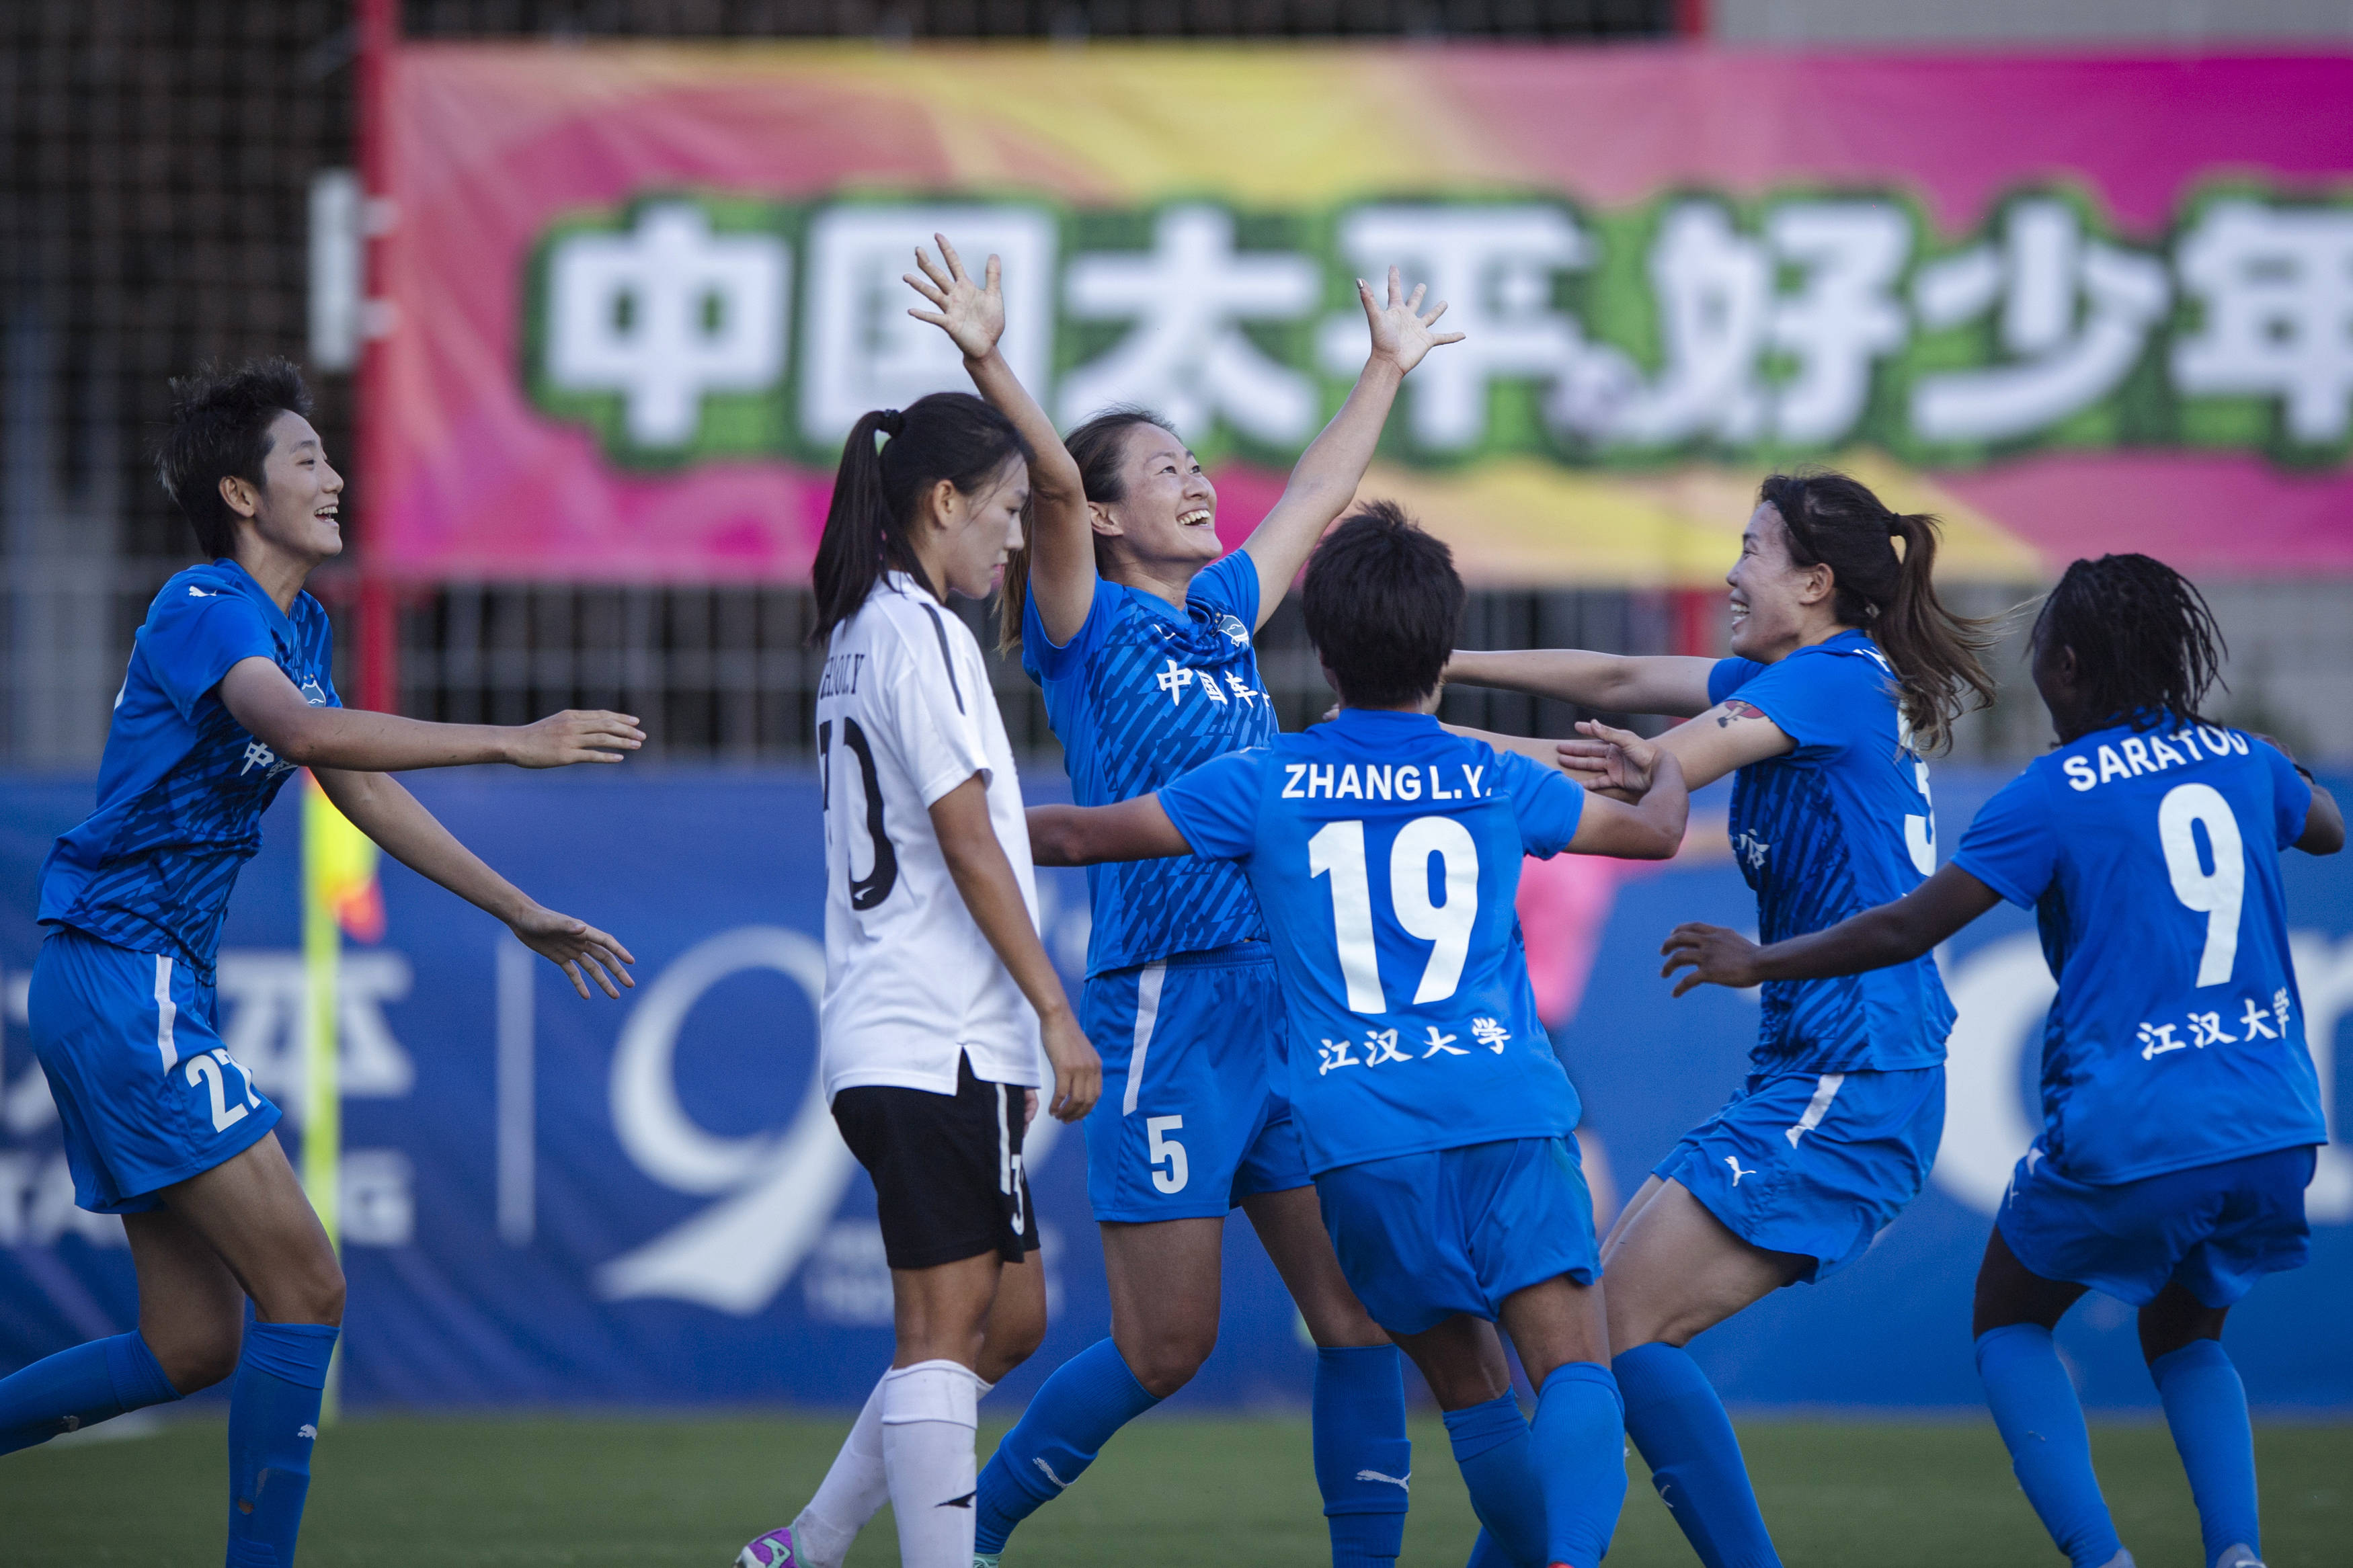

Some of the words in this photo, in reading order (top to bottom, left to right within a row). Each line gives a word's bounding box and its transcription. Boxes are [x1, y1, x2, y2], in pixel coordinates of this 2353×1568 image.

[546, 199, 2353, 446] 中国太平好少年
[1156, 659, 1271, 708] 中国车
[1281, 764, 1422, 801] ZHANG
[1429, 764, 1492, 801] L.Y.
[1308, 815, 1479, 1015] 19
[2158, 782, 2245, 989] 9
[1318, 1016, 1512, 1076] 江汉大学
[2135, 987, 2290, 1061] 江汉大学
[185, 1048, 262, 1134] 27
[1146, 1114, 1189, 1194] 5
